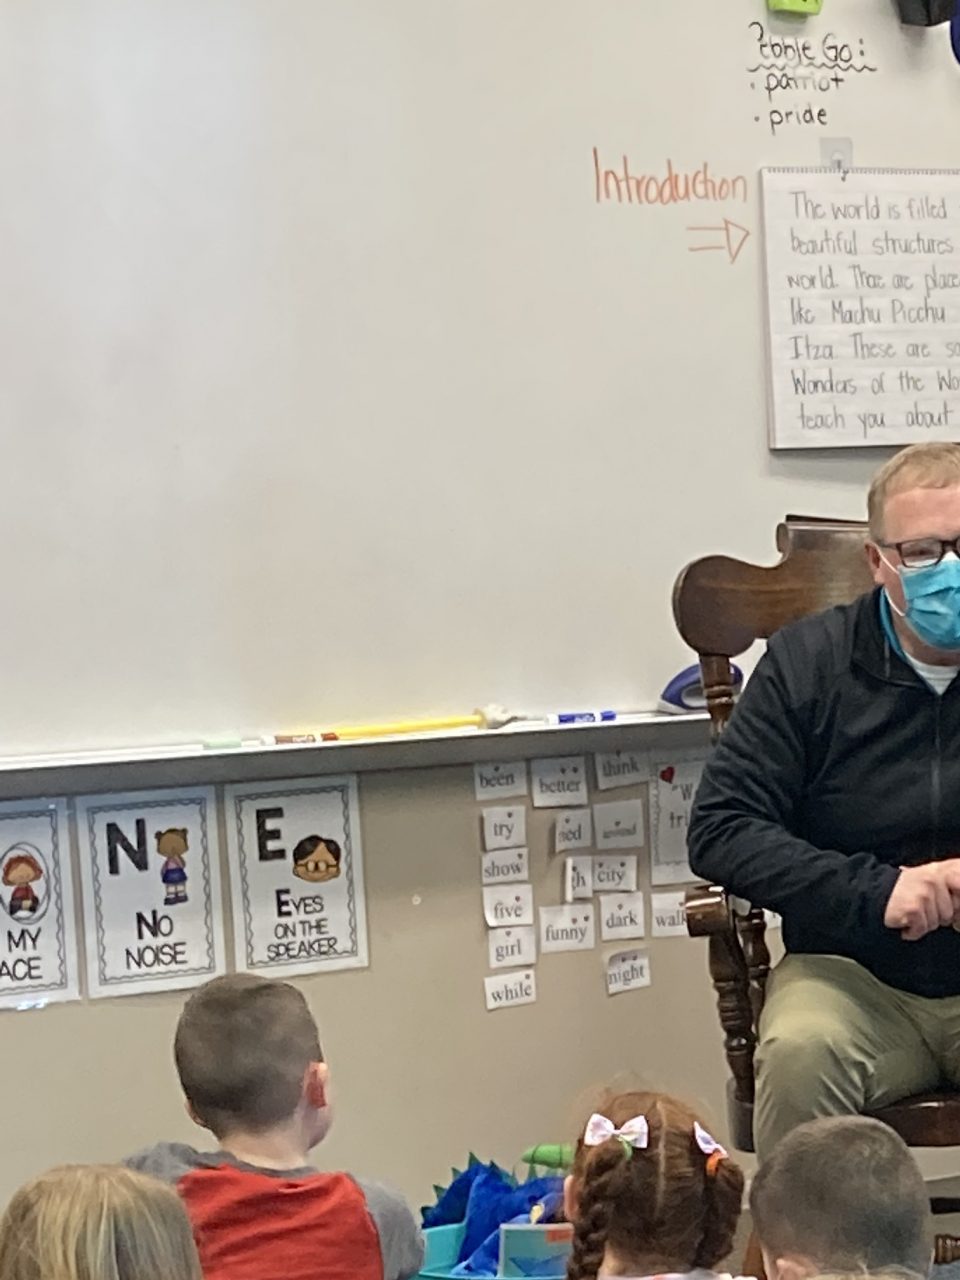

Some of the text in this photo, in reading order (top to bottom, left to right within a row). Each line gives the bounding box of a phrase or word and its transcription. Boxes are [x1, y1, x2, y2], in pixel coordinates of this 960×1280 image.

[769, 103, 827, 136] pride
[593, 147, 747, 205] Introduction
[788, 190, 826, 219] The
[831, 194, 881, 220] world
[887, 201, 901, 220] is
[907, 195, 947, 220] filled
[790, 227, 857, 255] beautiful
[872, 230, 954, 255] structures
[831, 296, 881, 325] Machu
[891, 296, 945, 324] Picchu
[848, 332, 897, 360] These
[906, 343, 930, 358] are
[790, 368, 857, 395] Wonders
[871, 371, 885, 395] of
[899, 370, 925, 393] the
[797, 400, 954, 439] teach you about
[479, 770, 516, 788] been
[602, 757, 640, 777] think
[539, 776, 581, 795] better
[255, 807, 287, 862] E
[493, 820, 515, 839] try
[106, 818, 149, 876] N
[484, 861, 523, 878] show
[597, 868, 626, 886] city
[493, 900, 523, 919] five
[606, 910, 639, 928] dark
[7, 926, 42, 953] MY
[274, 919, 329, 940] ON THE
[545, 924, 588, 943] funny
[125, 942, 188, 970] NOISE
[267, 936, 338, 961] SPEAKER
[495, 938, 522, 961] girl
[0, 956, 43, 981] ACE
[608, 962, 646, 987] night
[491, 981, 533, 1002] while
